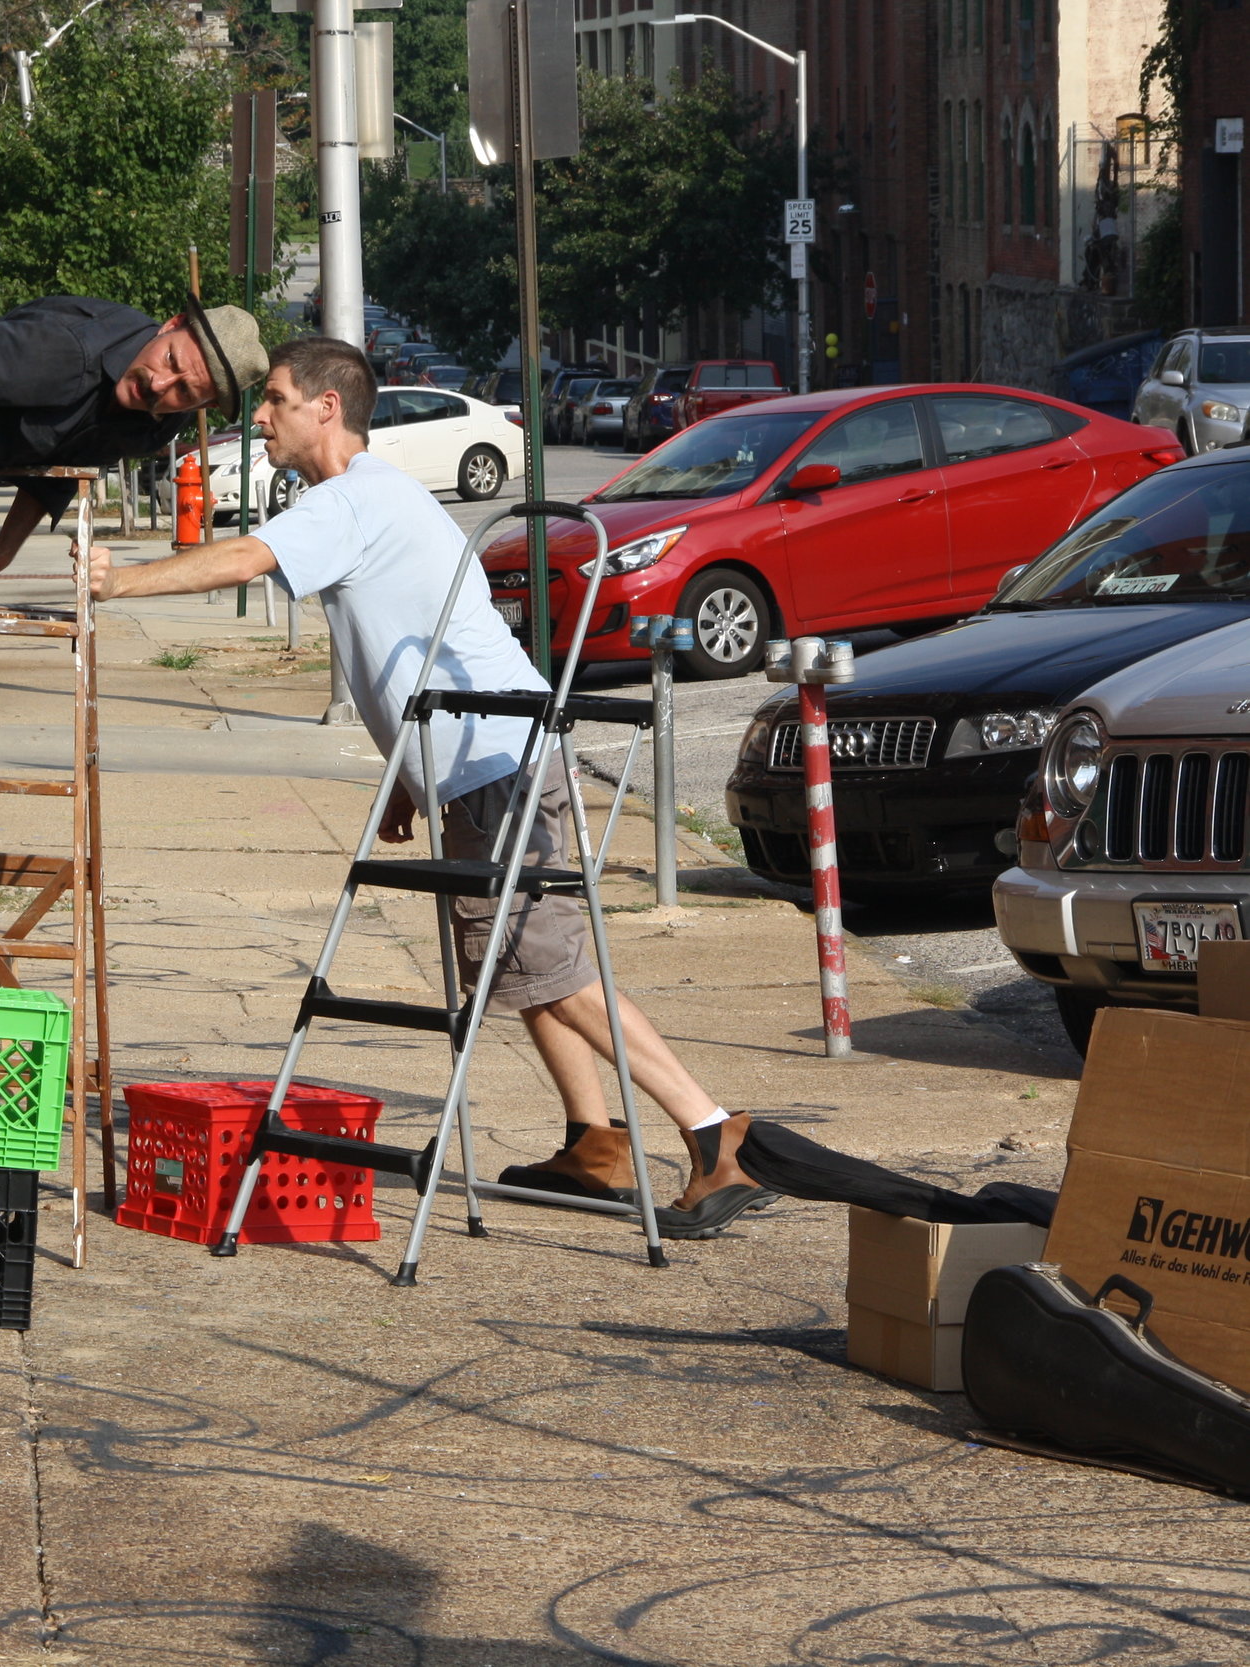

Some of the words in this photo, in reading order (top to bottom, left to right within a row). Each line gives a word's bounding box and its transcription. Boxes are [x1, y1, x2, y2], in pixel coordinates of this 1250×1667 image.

[790, 220, 812, 234] 25
[1161, 1209, 1250, 1263] GEHW
[1120, 1249, 1147, 1266] Alles
[1150, 1253, 1166, 1270] für
[1167, 1257, 1188, 1274] das
[1191, 1262, 1221, 1279] Wohl
[1221, 1267, 1241, 1283] der
